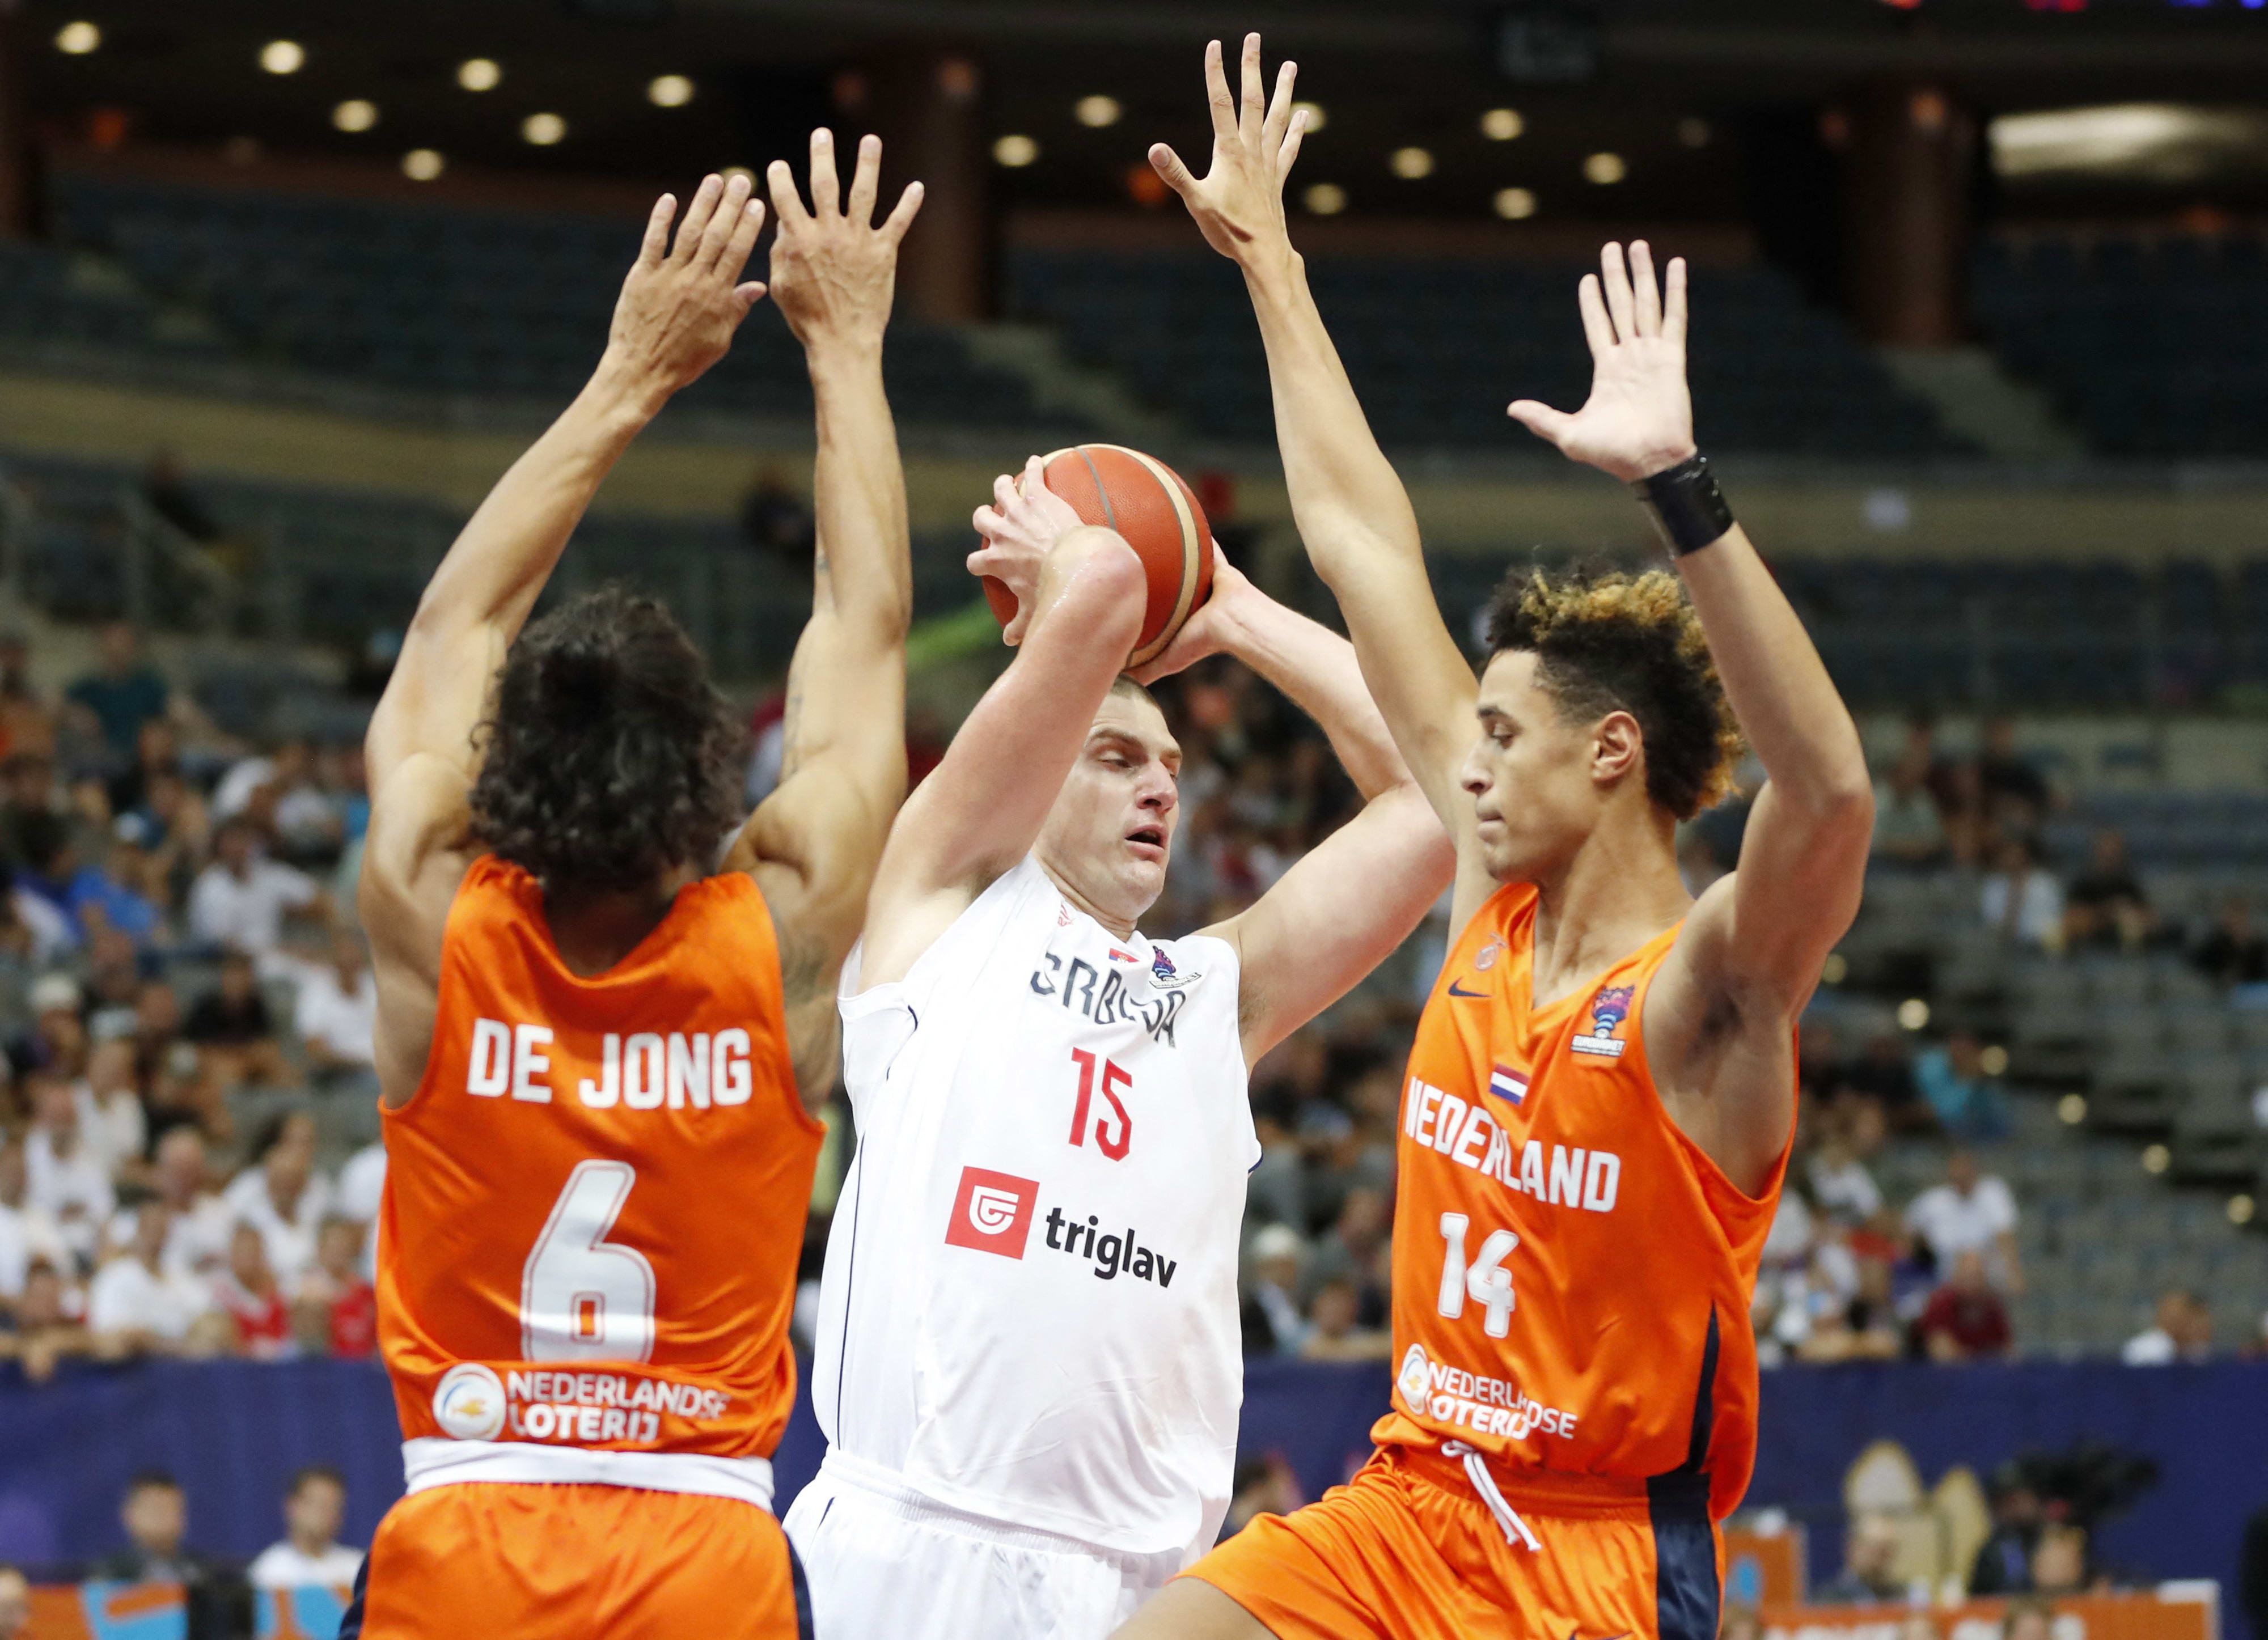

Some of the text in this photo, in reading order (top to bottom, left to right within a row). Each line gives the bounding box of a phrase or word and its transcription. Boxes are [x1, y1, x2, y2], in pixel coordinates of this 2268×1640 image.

[467, 1017, 752, 1109] DE JONG
[1068, 1046, 1133, 1162] 15
[1405, 1075, 1621, 1213] NEDERLAND
[520, 1158, 656, 1363] 6
[1046, 1207, 1177, 1289] triglav
[1437, 1211, 1520, 1339] 14
[510, 1402, 659, 1443] LOTERIJ
